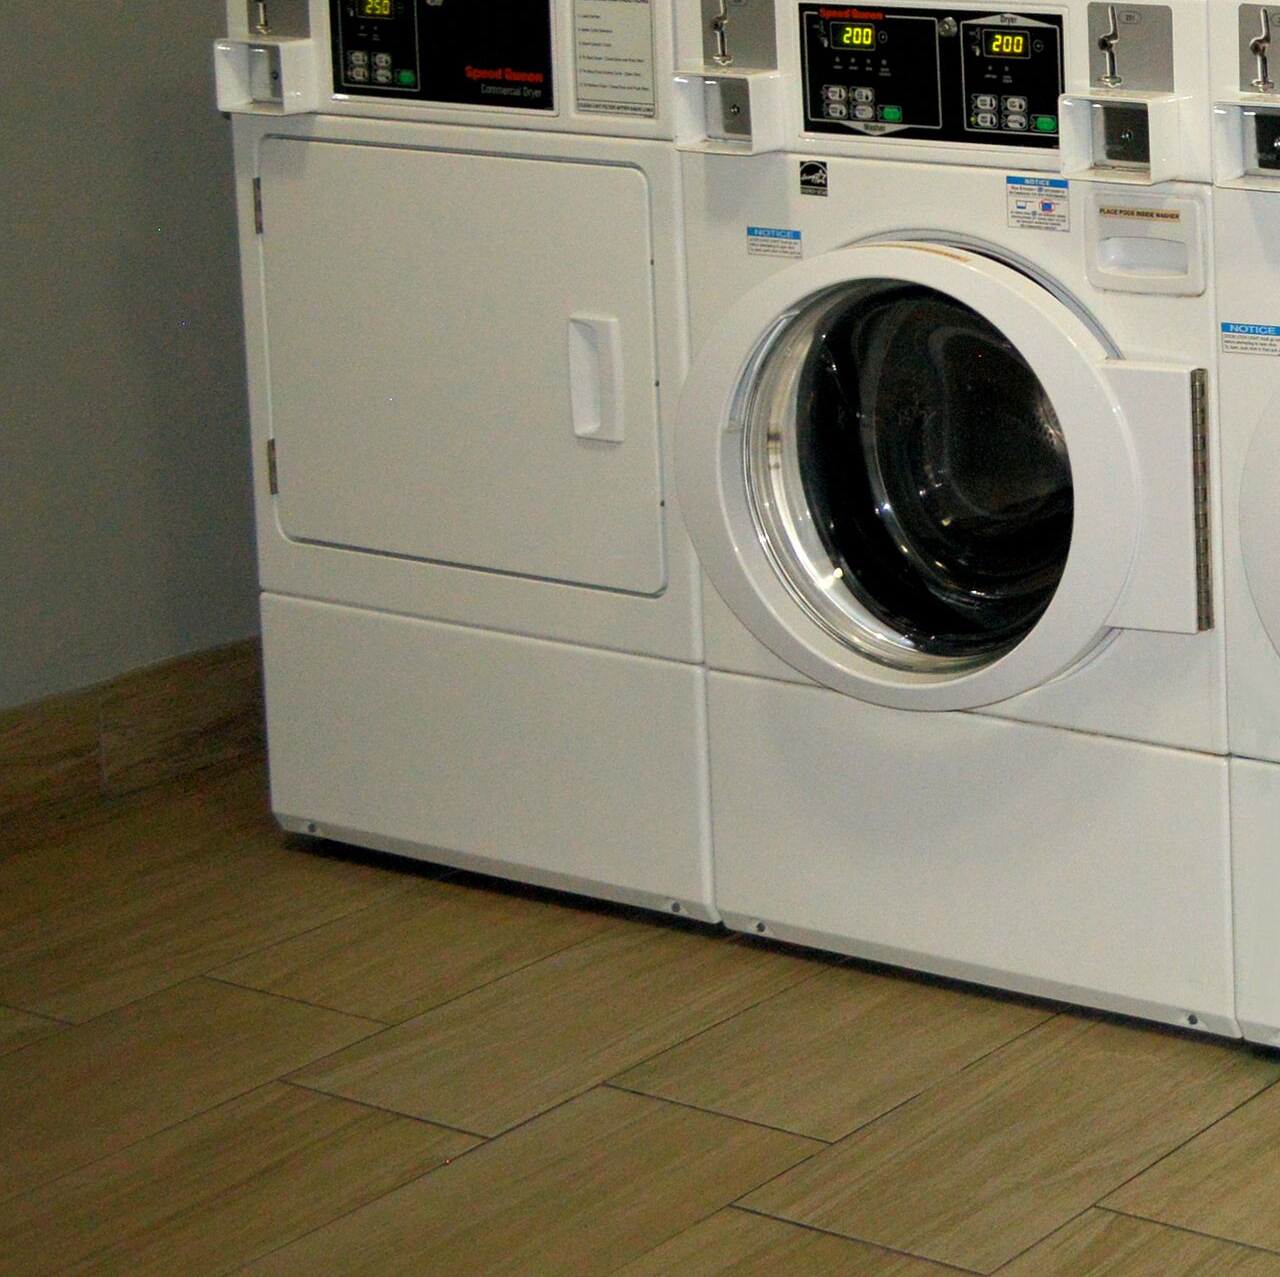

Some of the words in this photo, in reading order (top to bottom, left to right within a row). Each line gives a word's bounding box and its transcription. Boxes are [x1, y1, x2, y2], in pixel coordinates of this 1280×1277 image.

[365, 0, 390, 14] 250
[819, 8, 849, 19] Speed
[850, 9, 883, 20] Queen
[1000, 15, 1017, 24] Dryer
[843, 28, 872, 44] 200
[992, 35, 1023, 52] 200
[465, 66, 503, 80] Speed
[505, 68, 544, 82] Queen
[481, 84, 521, 96] Commercial
[524, 86, 542, 100] Dryer
[1100, 208, 1118, 216] PLACE
[755, 229, 793, 238] NOTICE
[1229, 324, 1276, 334] NOTICE
